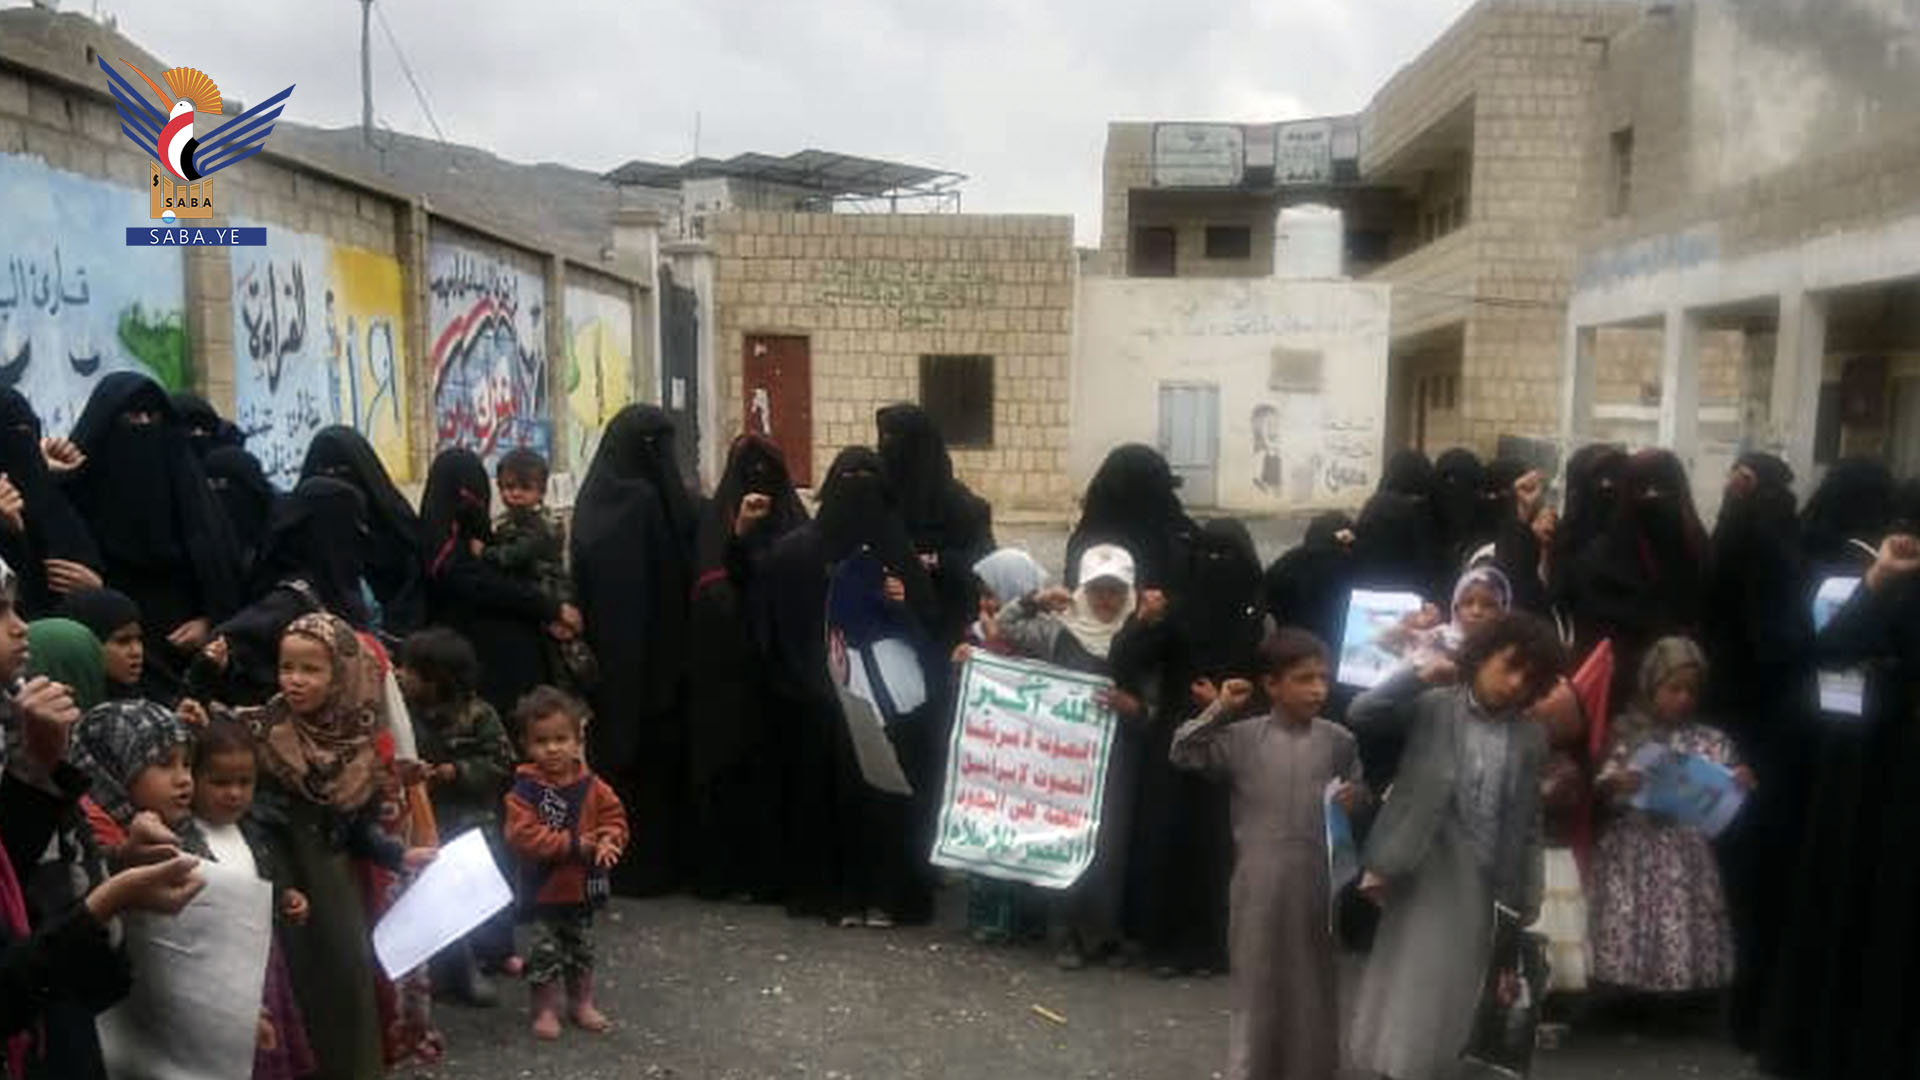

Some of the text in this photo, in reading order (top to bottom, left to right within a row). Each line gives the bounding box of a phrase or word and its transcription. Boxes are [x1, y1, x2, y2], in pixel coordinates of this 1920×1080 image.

[1050, 689, 1101, 725] الله
[1038, 737, 1098, 761] الموت
[1033, 770, 1093, 795] الموت
[956, 787, 1007, 812] اليهود
[1009, 798, 1037, 822] على
[1021, 835, 1084, 864] النصر
